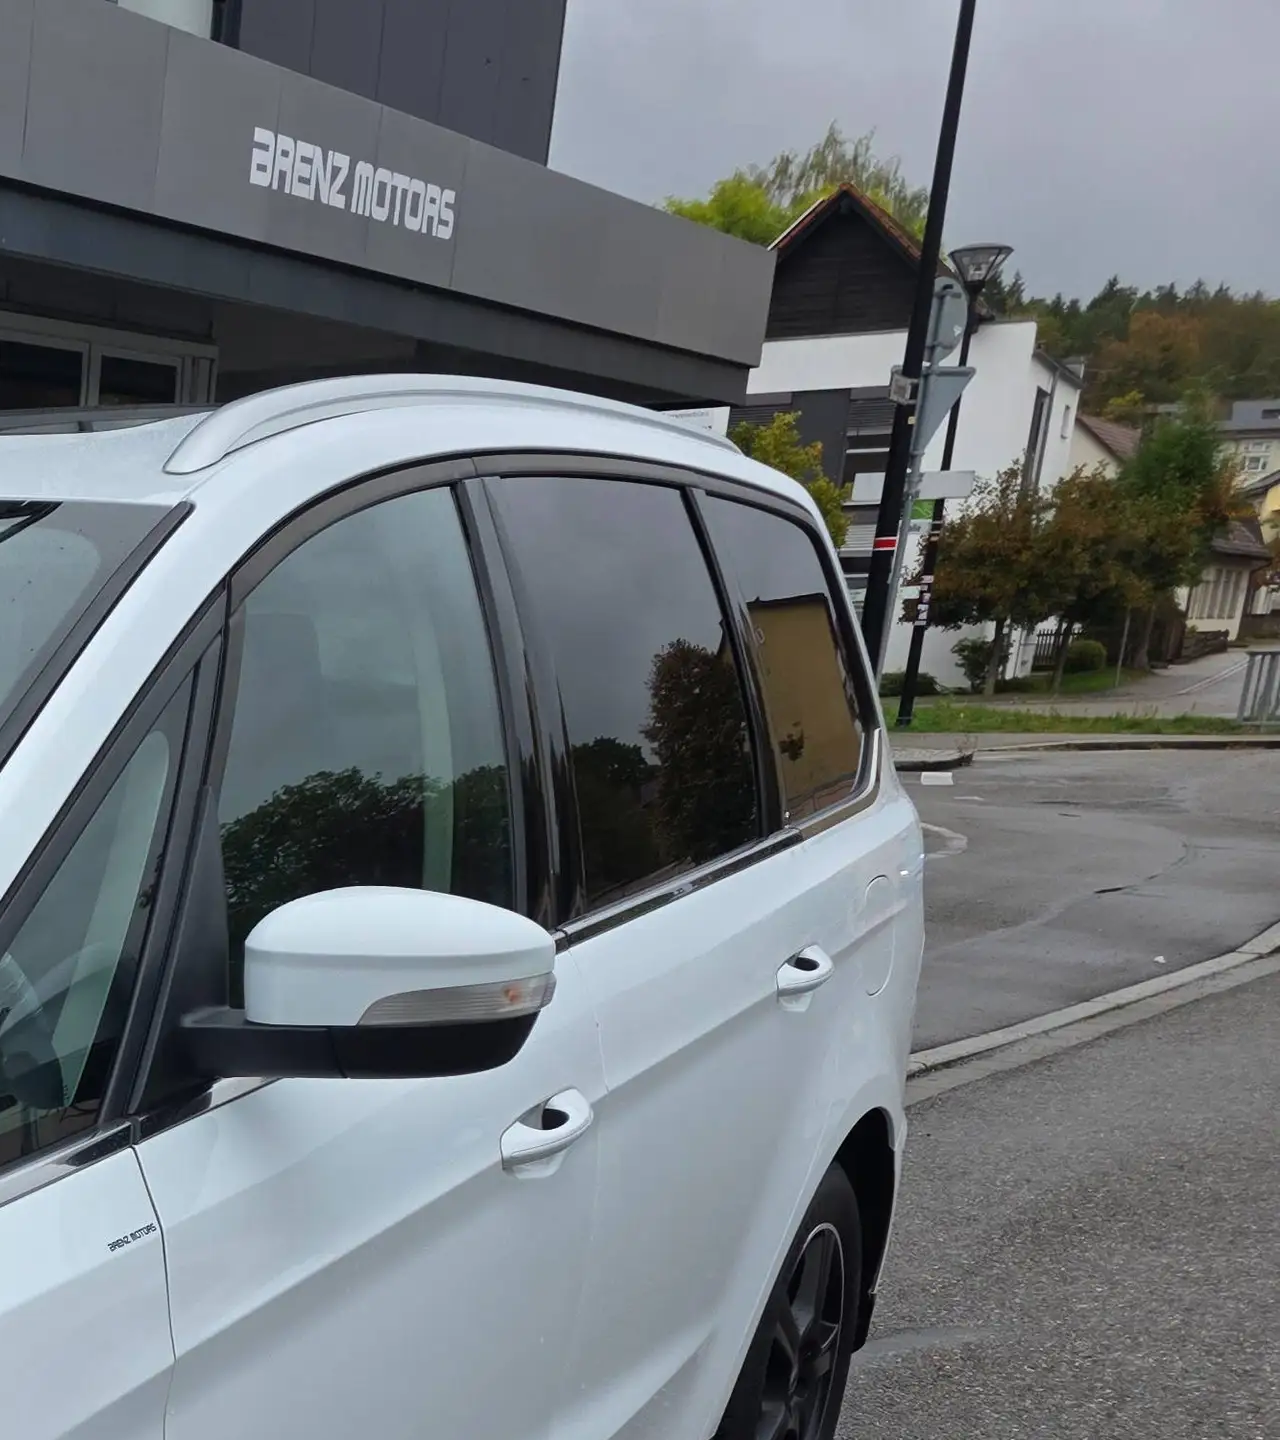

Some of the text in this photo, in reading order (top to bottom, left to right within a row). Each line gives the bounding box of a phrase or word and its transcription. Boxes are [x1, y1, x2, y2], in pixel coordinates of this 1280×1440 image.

[249, 126, 457, 240] BRENZ MOTORS
[129, 1222, 157, 1241] MOTORS
